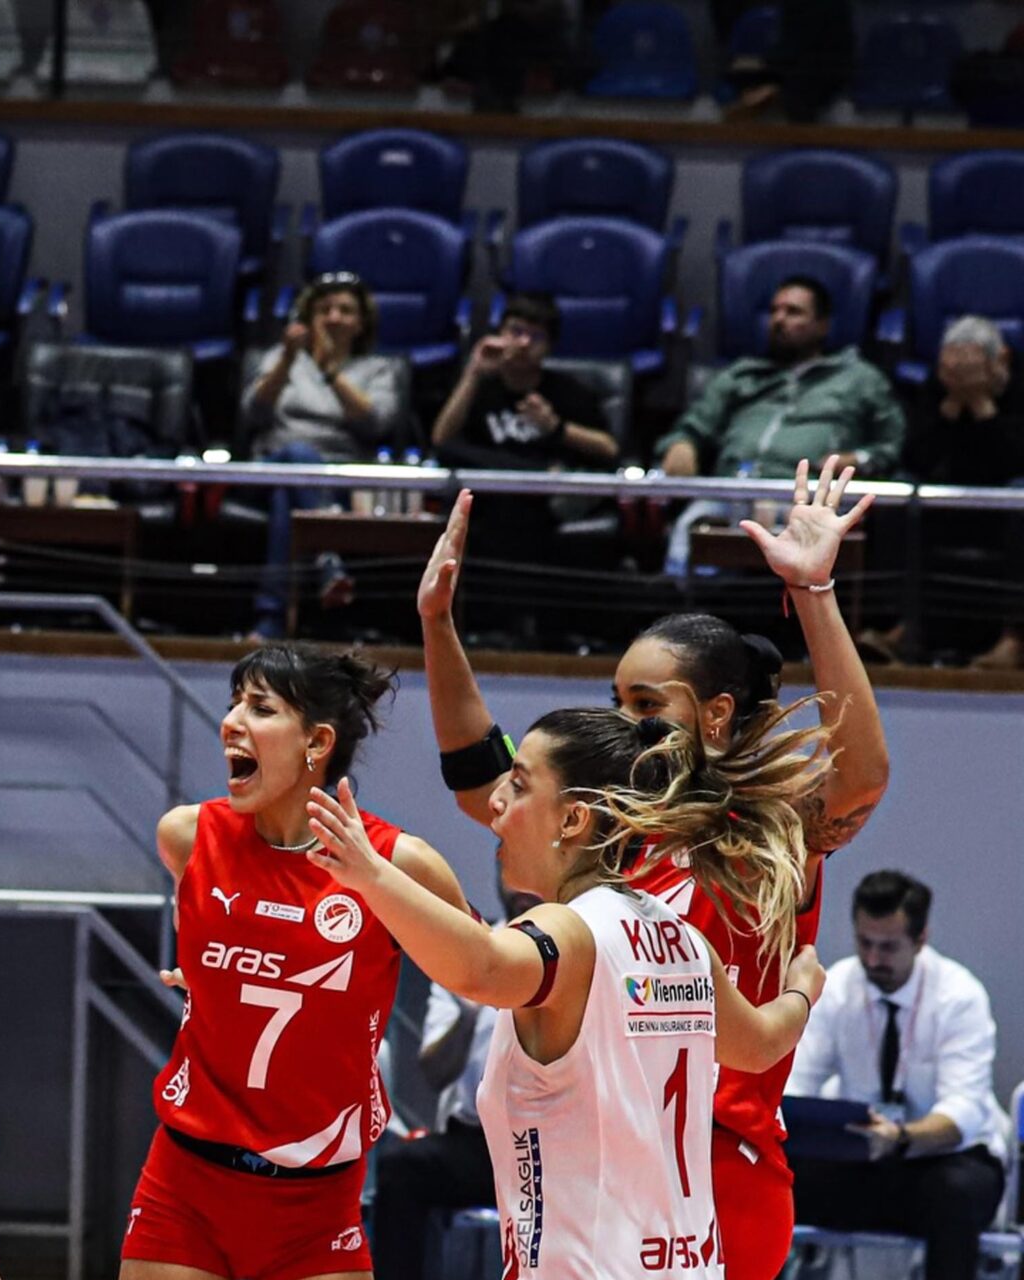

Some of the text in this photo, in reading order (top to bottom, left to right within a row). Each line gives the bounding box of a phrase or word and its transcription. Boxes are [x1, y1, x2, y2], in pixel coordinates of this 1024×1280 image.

[201, 941, 286, 979] aras
[240, 983, 304, 1090] 7
[663, 1048, 691, 1198] 1
